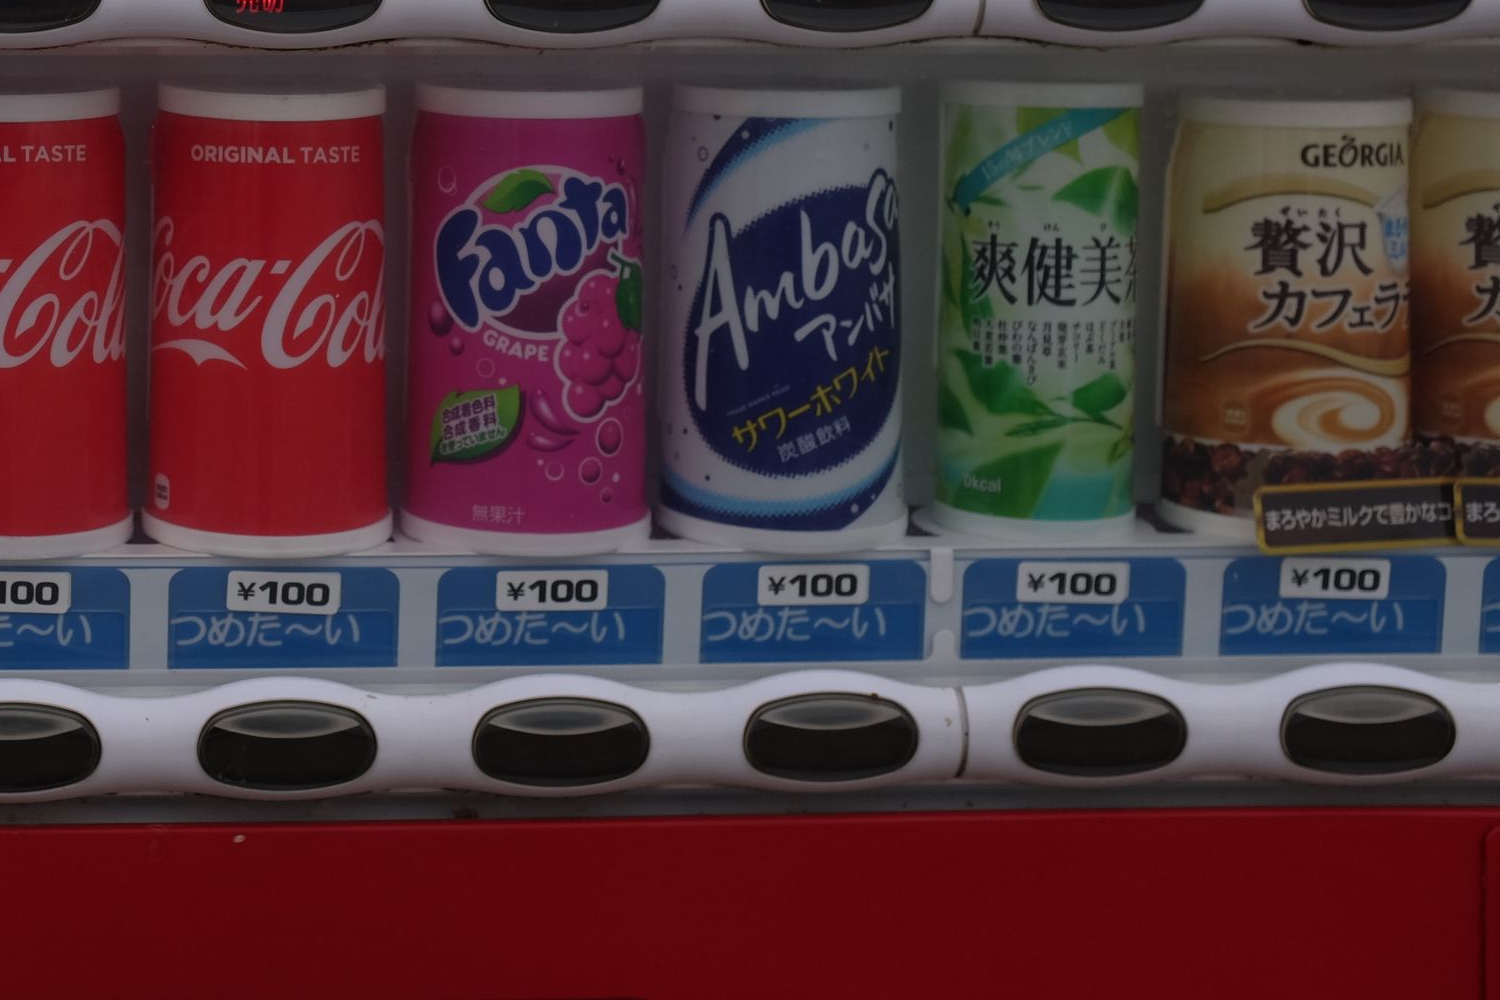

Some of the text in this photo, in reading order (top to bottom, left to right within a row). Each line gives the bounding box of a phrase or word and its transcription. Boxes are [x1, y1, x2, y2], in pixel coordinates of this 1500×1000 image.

[21, 145, 86, 163] TASTE
[191, 145, 360, 164] ORIGINAL TASTE
[1301, 134, 1404, 167] GEORGIA
[437, 178, 627, 328] Fanta
[1244, 218, 1373, 277] 贅沢
[483, 331, 548, 362] GRAPE
[731, 345, 890, 453] サワーホワイト
[777, 416, 852, 462] 炭酸飲料
[472, 504, 525, 525] 無果汁
[507, 579, 598, 604] ¥100
[768, 574, 857, 598] ¥100
[1027, 572, 1117, 596] ¥100
[1291, 568, 1380, 592] ¥100
[237, 581, 330, 607] ¥100
